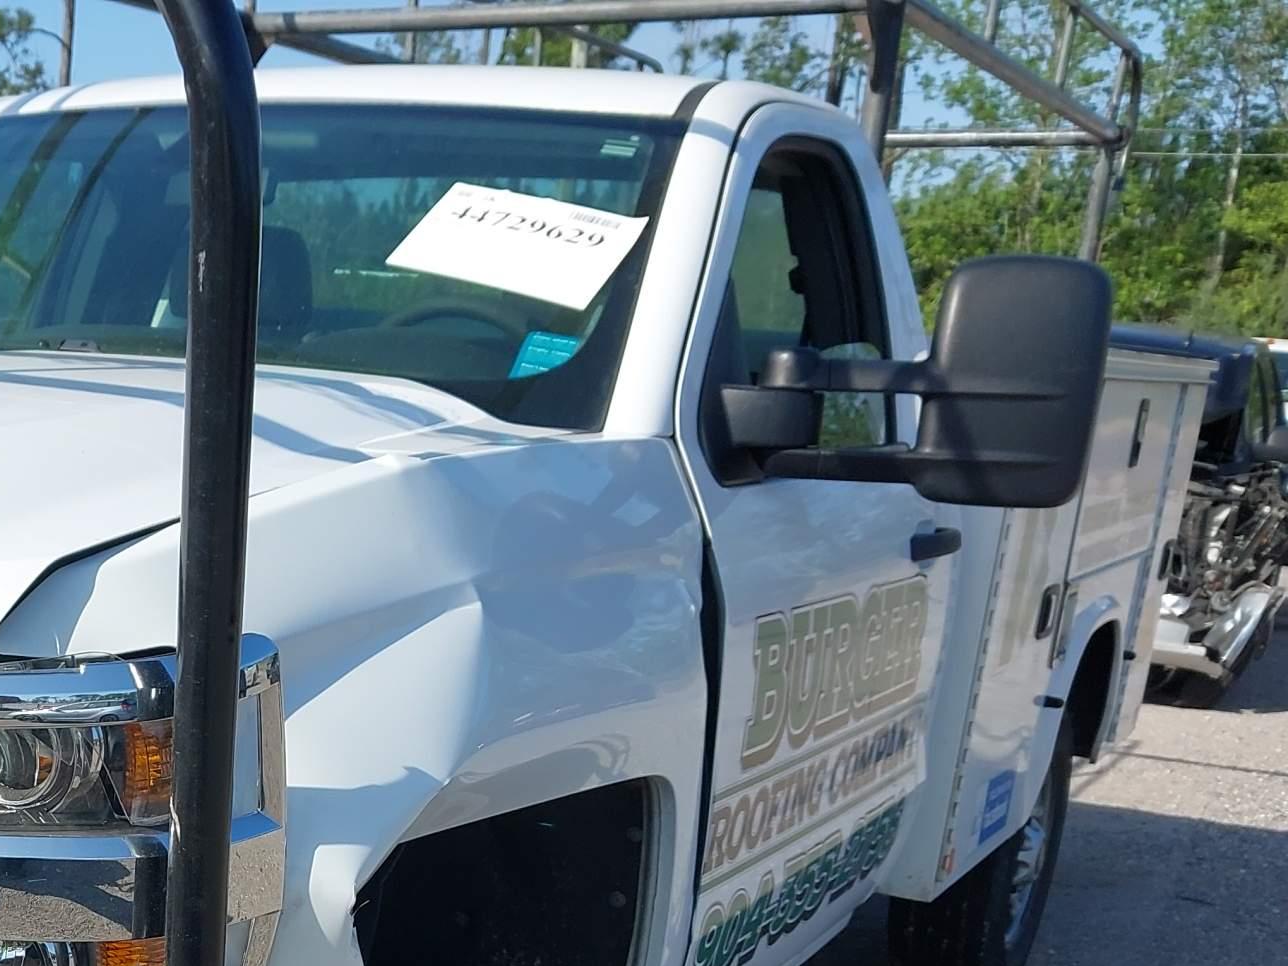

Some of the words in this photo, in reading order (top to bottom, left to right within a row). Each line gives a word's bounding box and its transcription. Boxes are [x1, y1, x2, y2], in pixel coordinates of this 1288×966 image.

[451, 205, 605, 248] 44729629
[740, 573, 929, 770] BURGER
[703, 757, 829, 874] ROOFING
